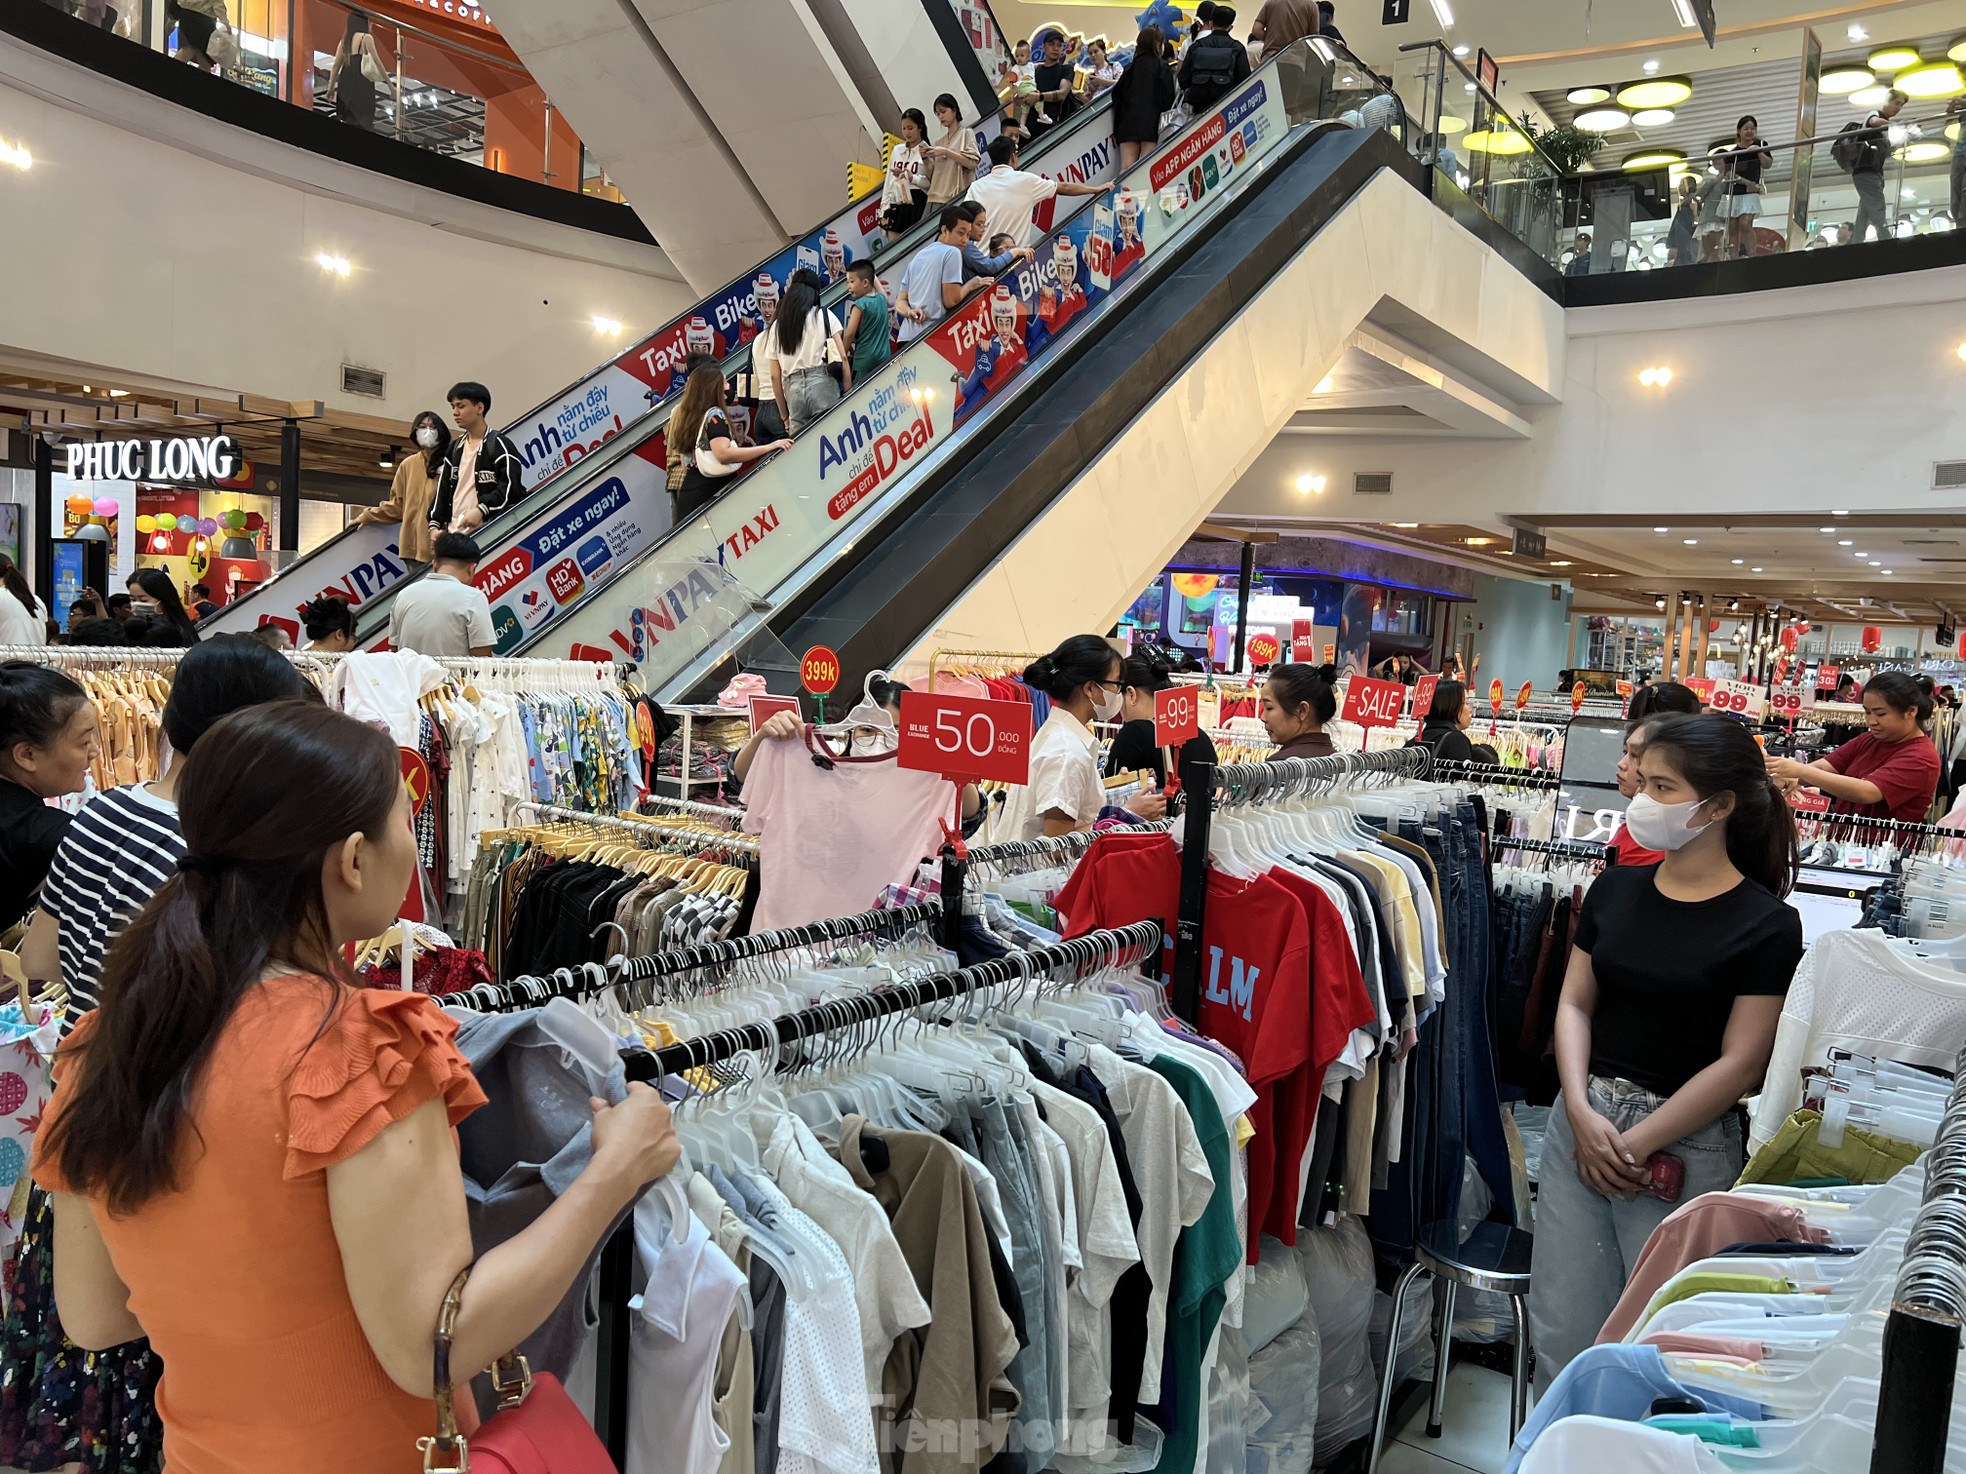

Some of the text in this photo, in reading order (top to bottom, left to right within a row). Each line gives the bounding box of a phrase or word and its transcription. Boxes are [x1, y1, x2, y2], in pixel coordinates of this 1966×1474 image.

[1391, 0, 1400, 17] 1
[1165, 155, 1180, 177] APP
[1017, 258, 1058, 303] Bike
[714, 293, 758, 332] Bike
[946, 300, 993, 357] Taxi
[639, 328, 688, 378] Taxi
[557, 384, 608, 428] nằm đây
[868, 385, 896, 416] nằm
[562, 403, 611, 443] từ chiều
[873, 410, 888, 434] từ
[66, 434, 234, 482] PHUC LONG
[819, 410, 874, 481] Anh
[848, 459, 862, 480] chỉ
[873, 401, 934, 481] Deal
[834, 473, 875, 513] tặng em
[537, 485, 621, 555] Đặt xe ngay!
[550, 567, 570, 589] HD
[555, 576, 579, 598] Bank
[1251, 637, 1277, 660] 199K
[1821, 668, 1836, 676] SALE
[1167, 696, 1189, 729] 99
[1358, 685, 1400, 721] SALE
[1713, 690, 1748, 712] 99
[1771, 693, 1802, 710] 99
[909, 723, 930, 733] BLUE
[934, 708, 1020, 757] 50 .000
